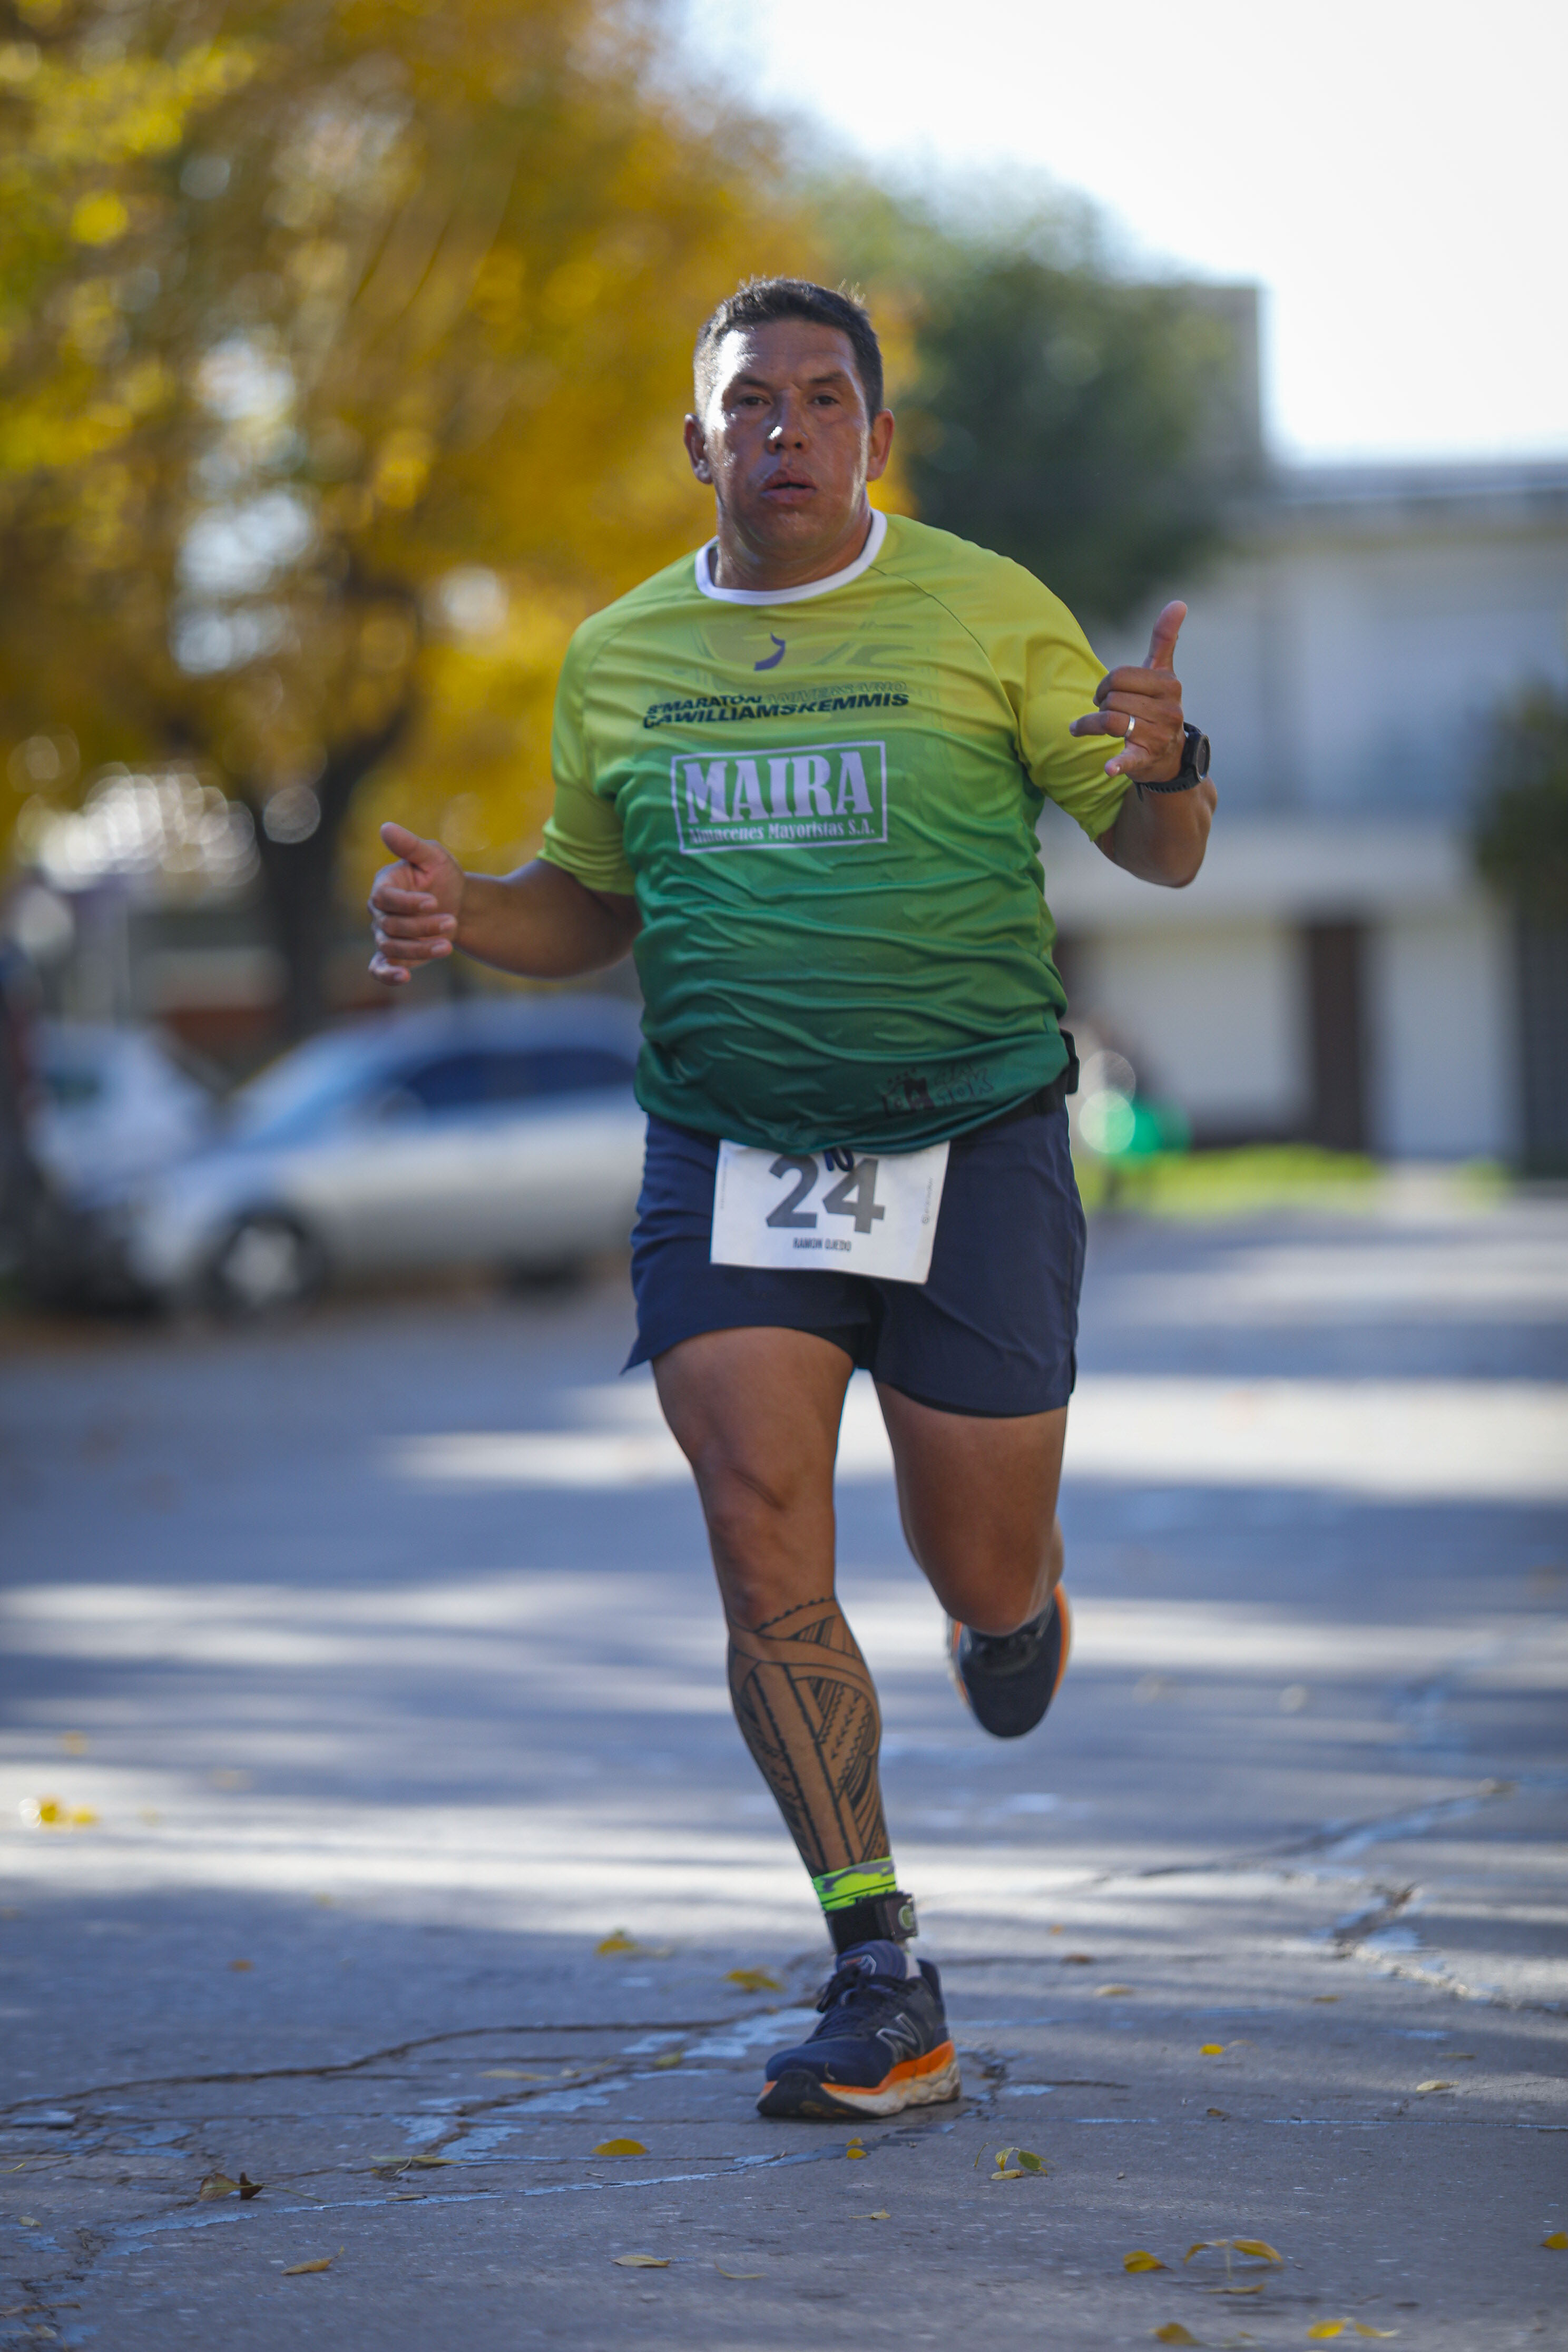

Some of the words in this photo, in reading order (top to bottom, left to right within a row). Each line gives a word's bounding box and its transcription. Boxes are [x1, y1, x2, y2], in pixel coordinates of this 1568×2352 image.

[683, 750, 874, 824] MAIRA
[688, 826, 764, 844] Almacenes
[768, 820, 844, 840] Mayoristas
[848, 817, 875, 835] S.A.
[766, 1154, 885, 1234] 24
